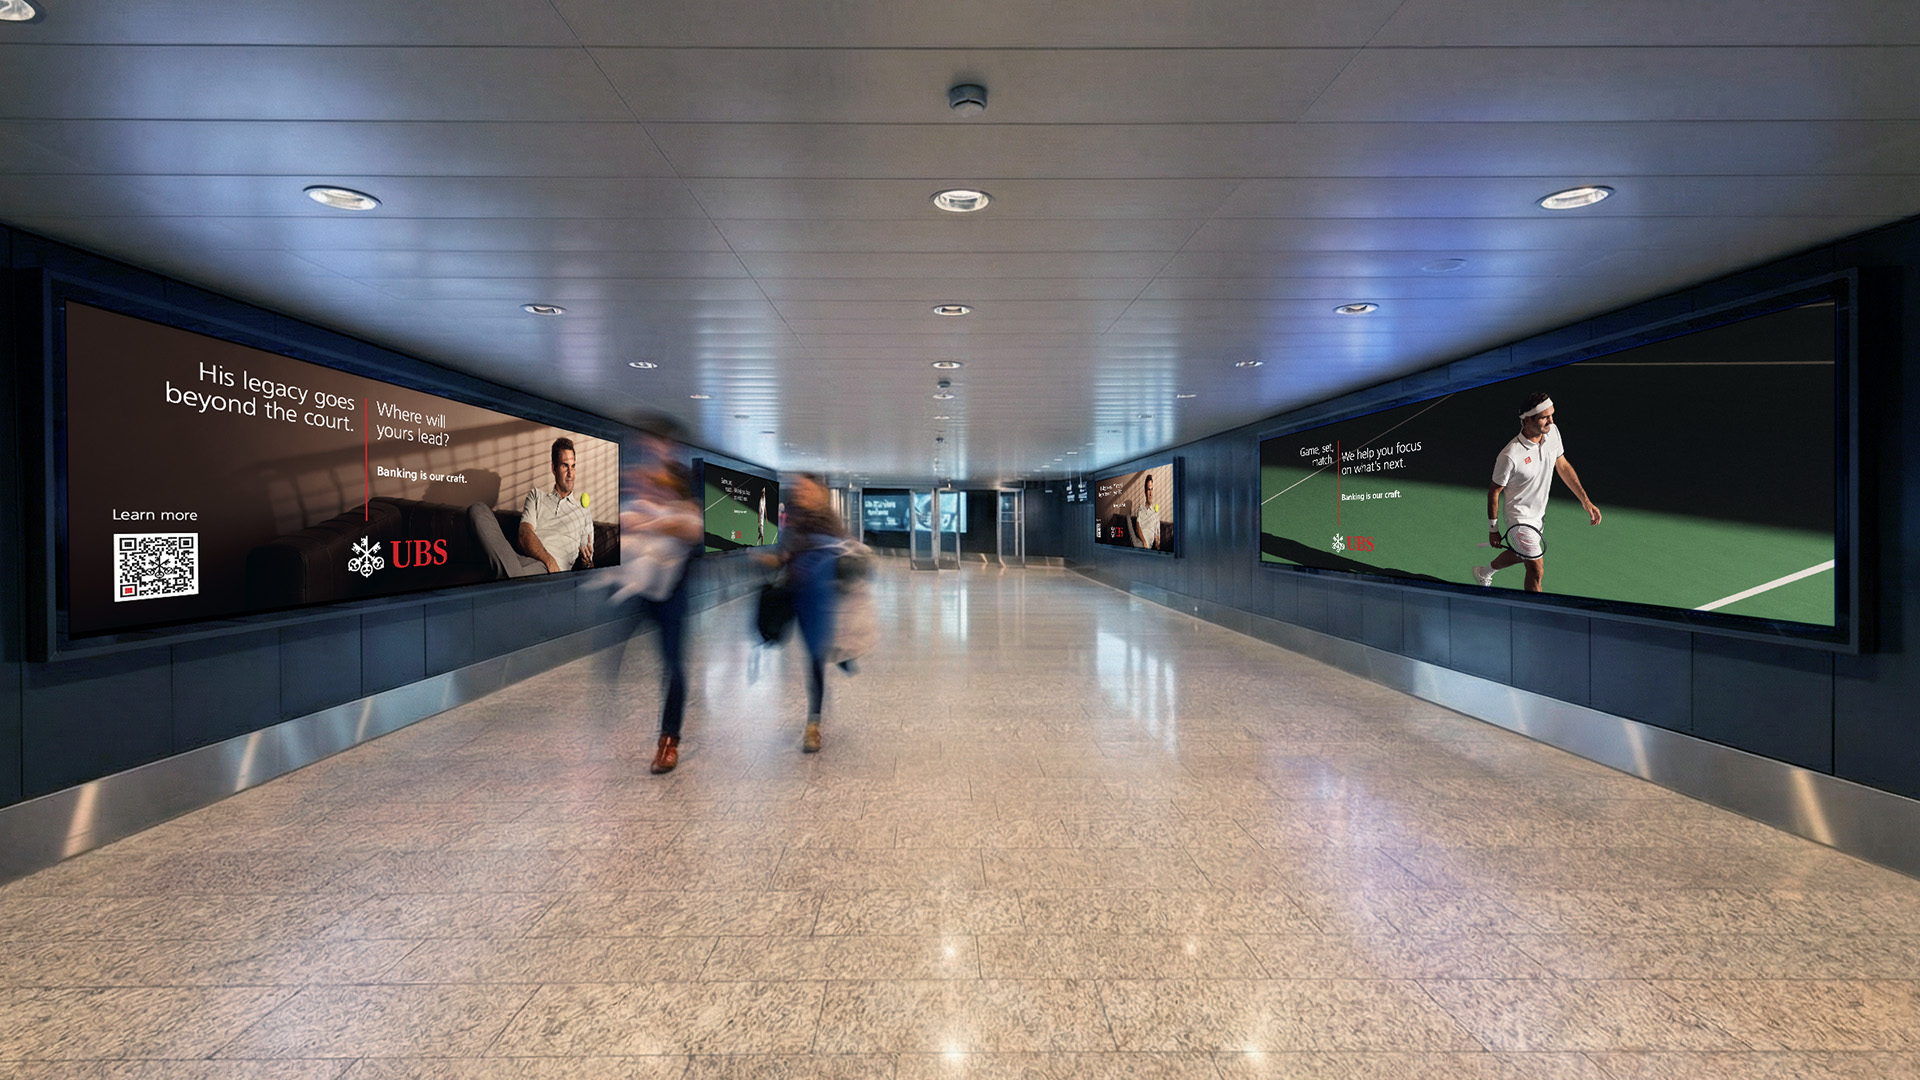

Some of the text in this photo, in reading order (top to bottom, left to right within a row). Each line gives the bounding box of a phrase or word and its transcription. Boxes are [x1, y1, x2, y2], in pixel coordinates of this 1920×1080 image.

[199, 361, 355, 411] His legacy goes
[165, 380, 355, 432] beyond the court.
[376, 400, 446, 429] Where will
[376, 424, 450, 447] yours lead?
[1299, 446, 1321, 457] Game,
[1341, 441, 1422, 462] We help you focus
[377, 465, 468, 484] Banking is our craft.
[1341, 457, 1406, 476] on what's next.
[1341, 489, 1403, 502] Banking is our craft.
[112, 508, 198, 522] Learn more
[390, 538, 448, 569] UBS
[1346, 535, 1375, 552] UBS
